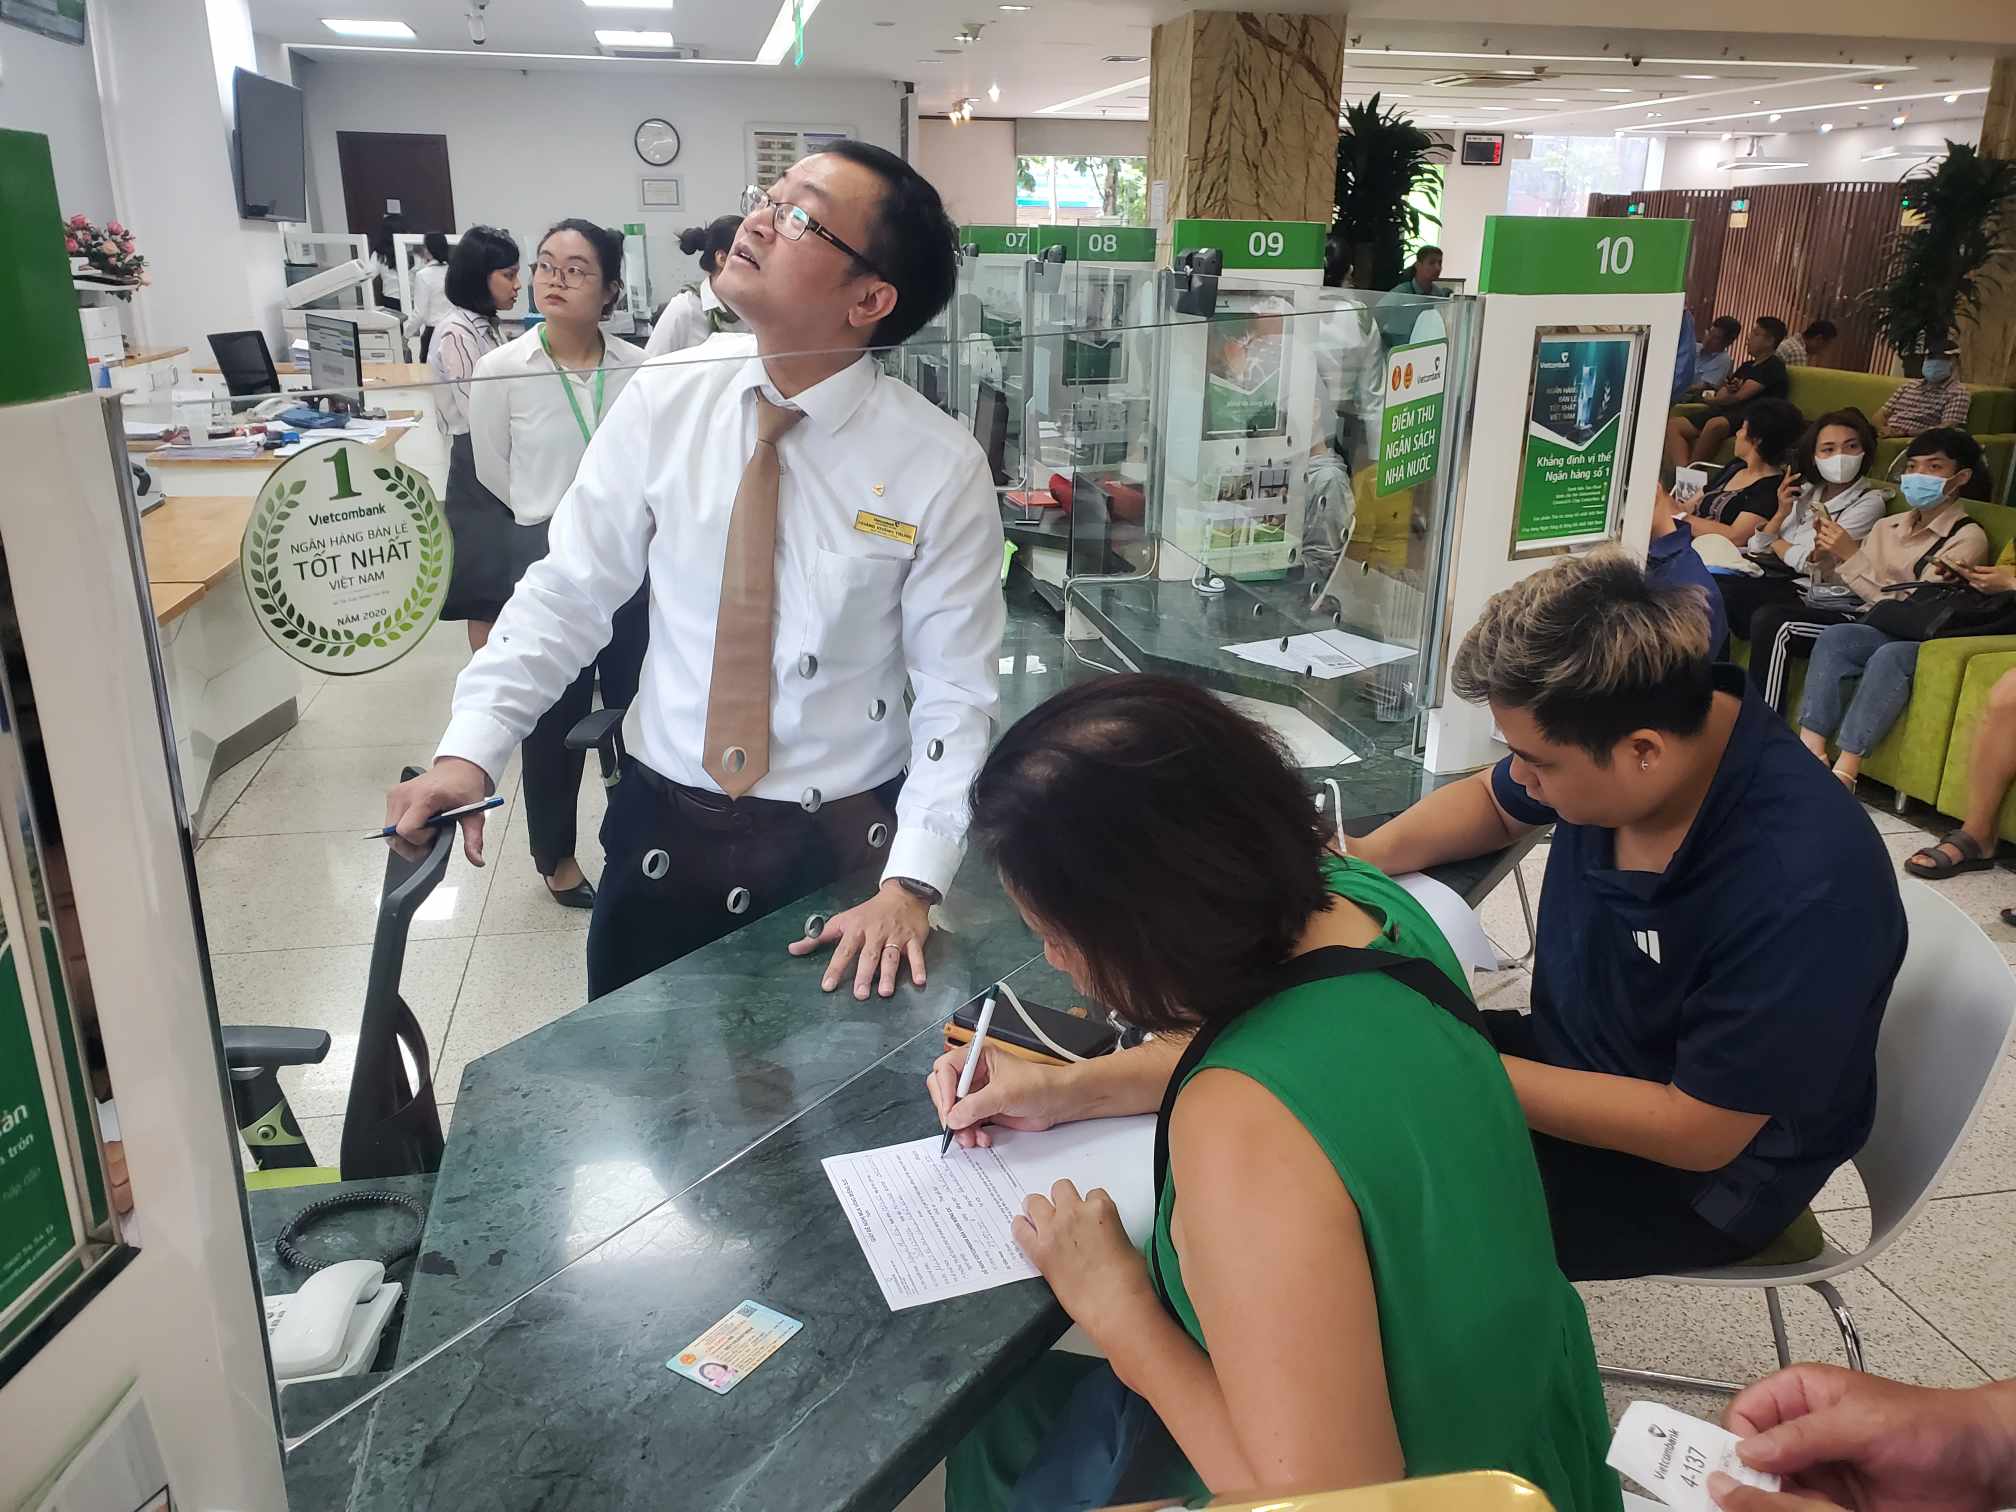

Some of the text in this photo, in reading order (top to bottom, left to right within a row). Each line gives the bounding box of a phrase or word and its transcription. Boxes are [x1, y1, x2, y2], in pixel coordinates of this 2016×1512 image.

[1005, 232, 1027, 248] 07
[1088, 234, 1117, 252] 08
[1248, 231, 1284, 257] 09
[1596, 236, 1634, 275] 10
[1391, 404, 1435, 433] ĐIỂM THU
[1385, 428, 1436, 461] NGÂN SÁCH
[1566, 454, 1585, 466] định
[1587, 453, 1595, 464] vị
[1597, 450, 1613, 463] thế
[323, 447, 362, 501] 1
[1384, 460, 1405, 487] NHÀ
[1545, 466, 1610, 483] Ngân hàng số 1
[308, 502, 386, 527] Vietcombank
[290, 537, 326, 556] NGÂN
[330, 531, 364, 548] HÀNG
[293, 536, 412, 581] TỐT NHẤT
[328, 570, 385, 591] VIỆT NAM
[363, 608, 387, 621] 2020
